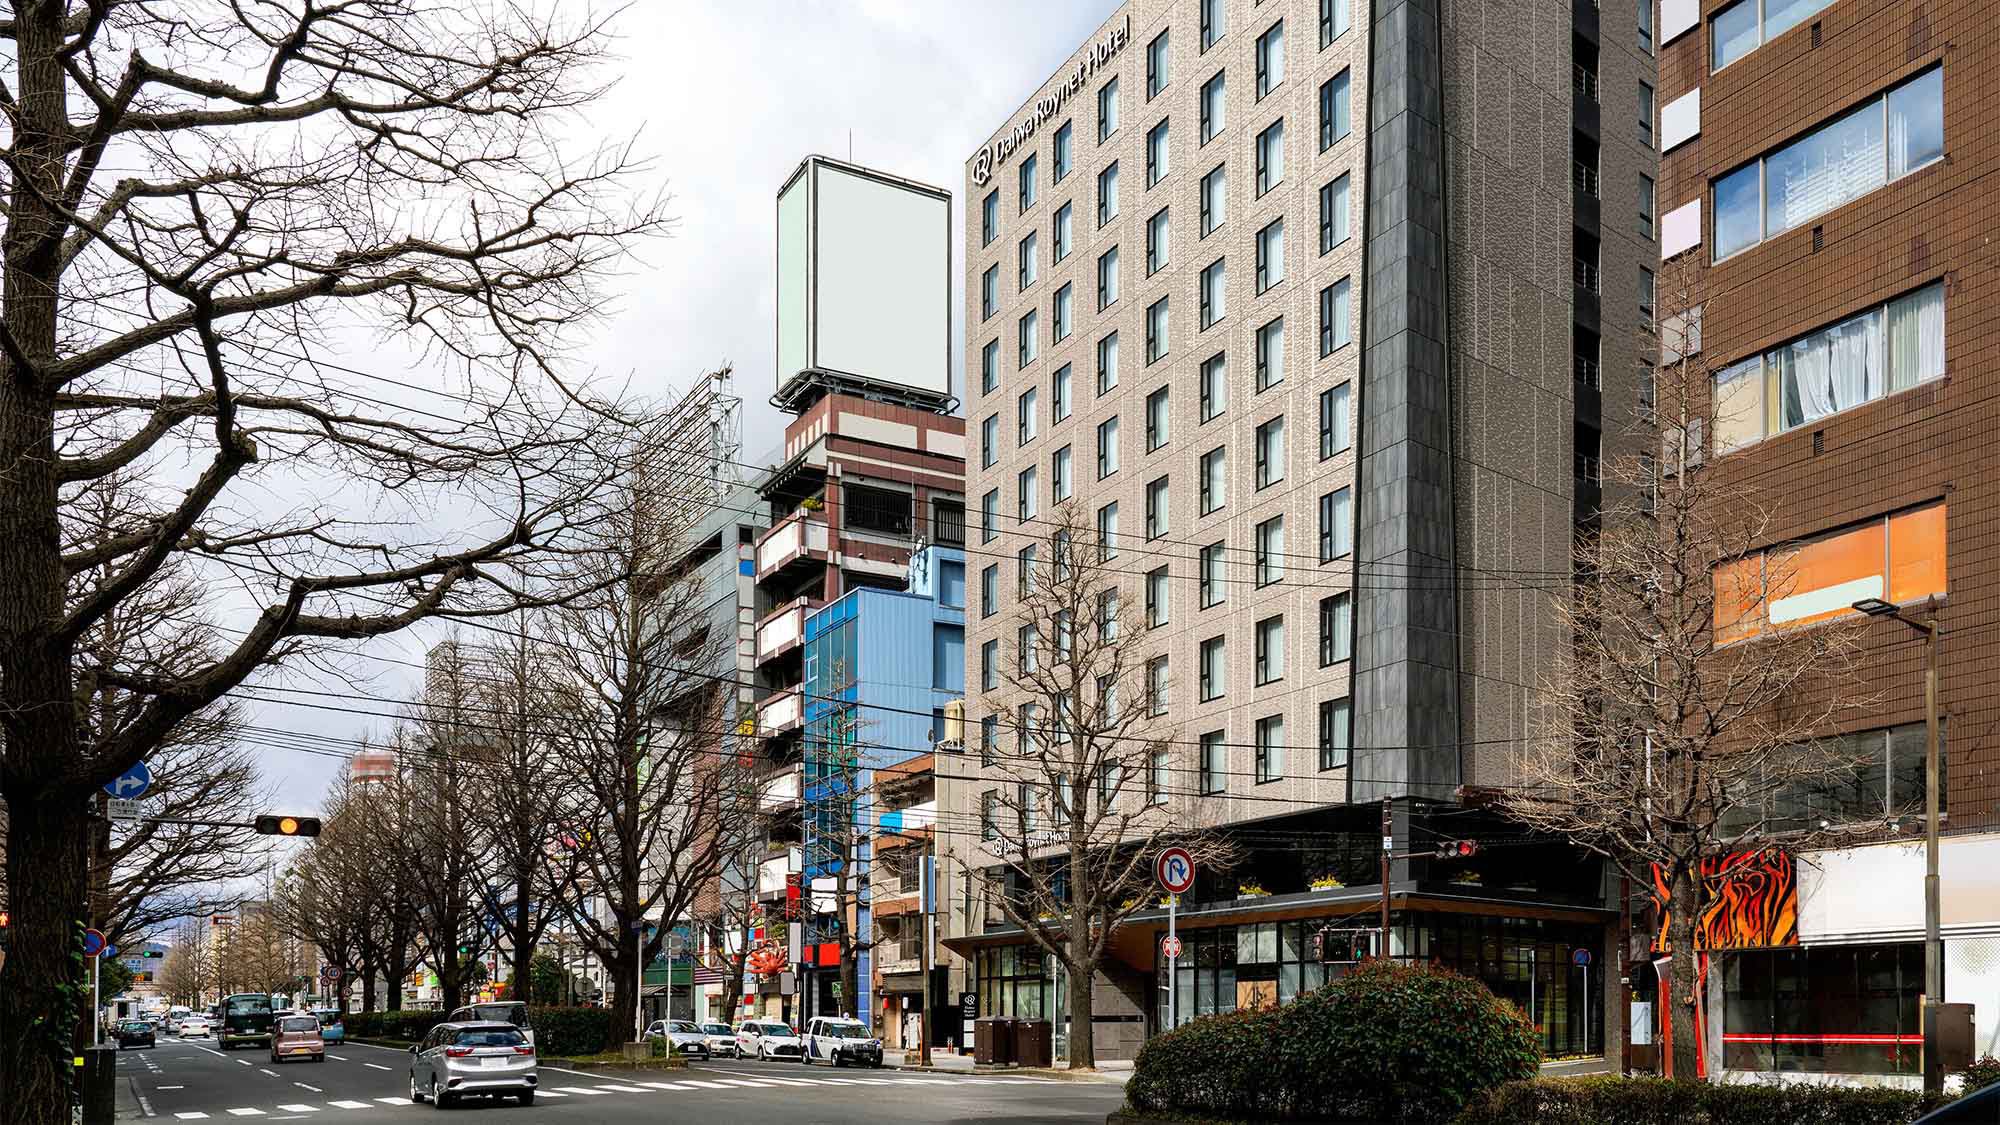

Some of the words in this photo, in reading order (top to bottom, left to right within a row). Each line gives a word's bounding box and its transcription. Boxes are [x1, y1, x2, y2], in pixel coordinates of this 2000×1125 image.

[996, 117, 1034, 165] Daiwa
[1034, 62, 1086, 126] Roynet
[1088, 14, 1130, 78] Hotel
